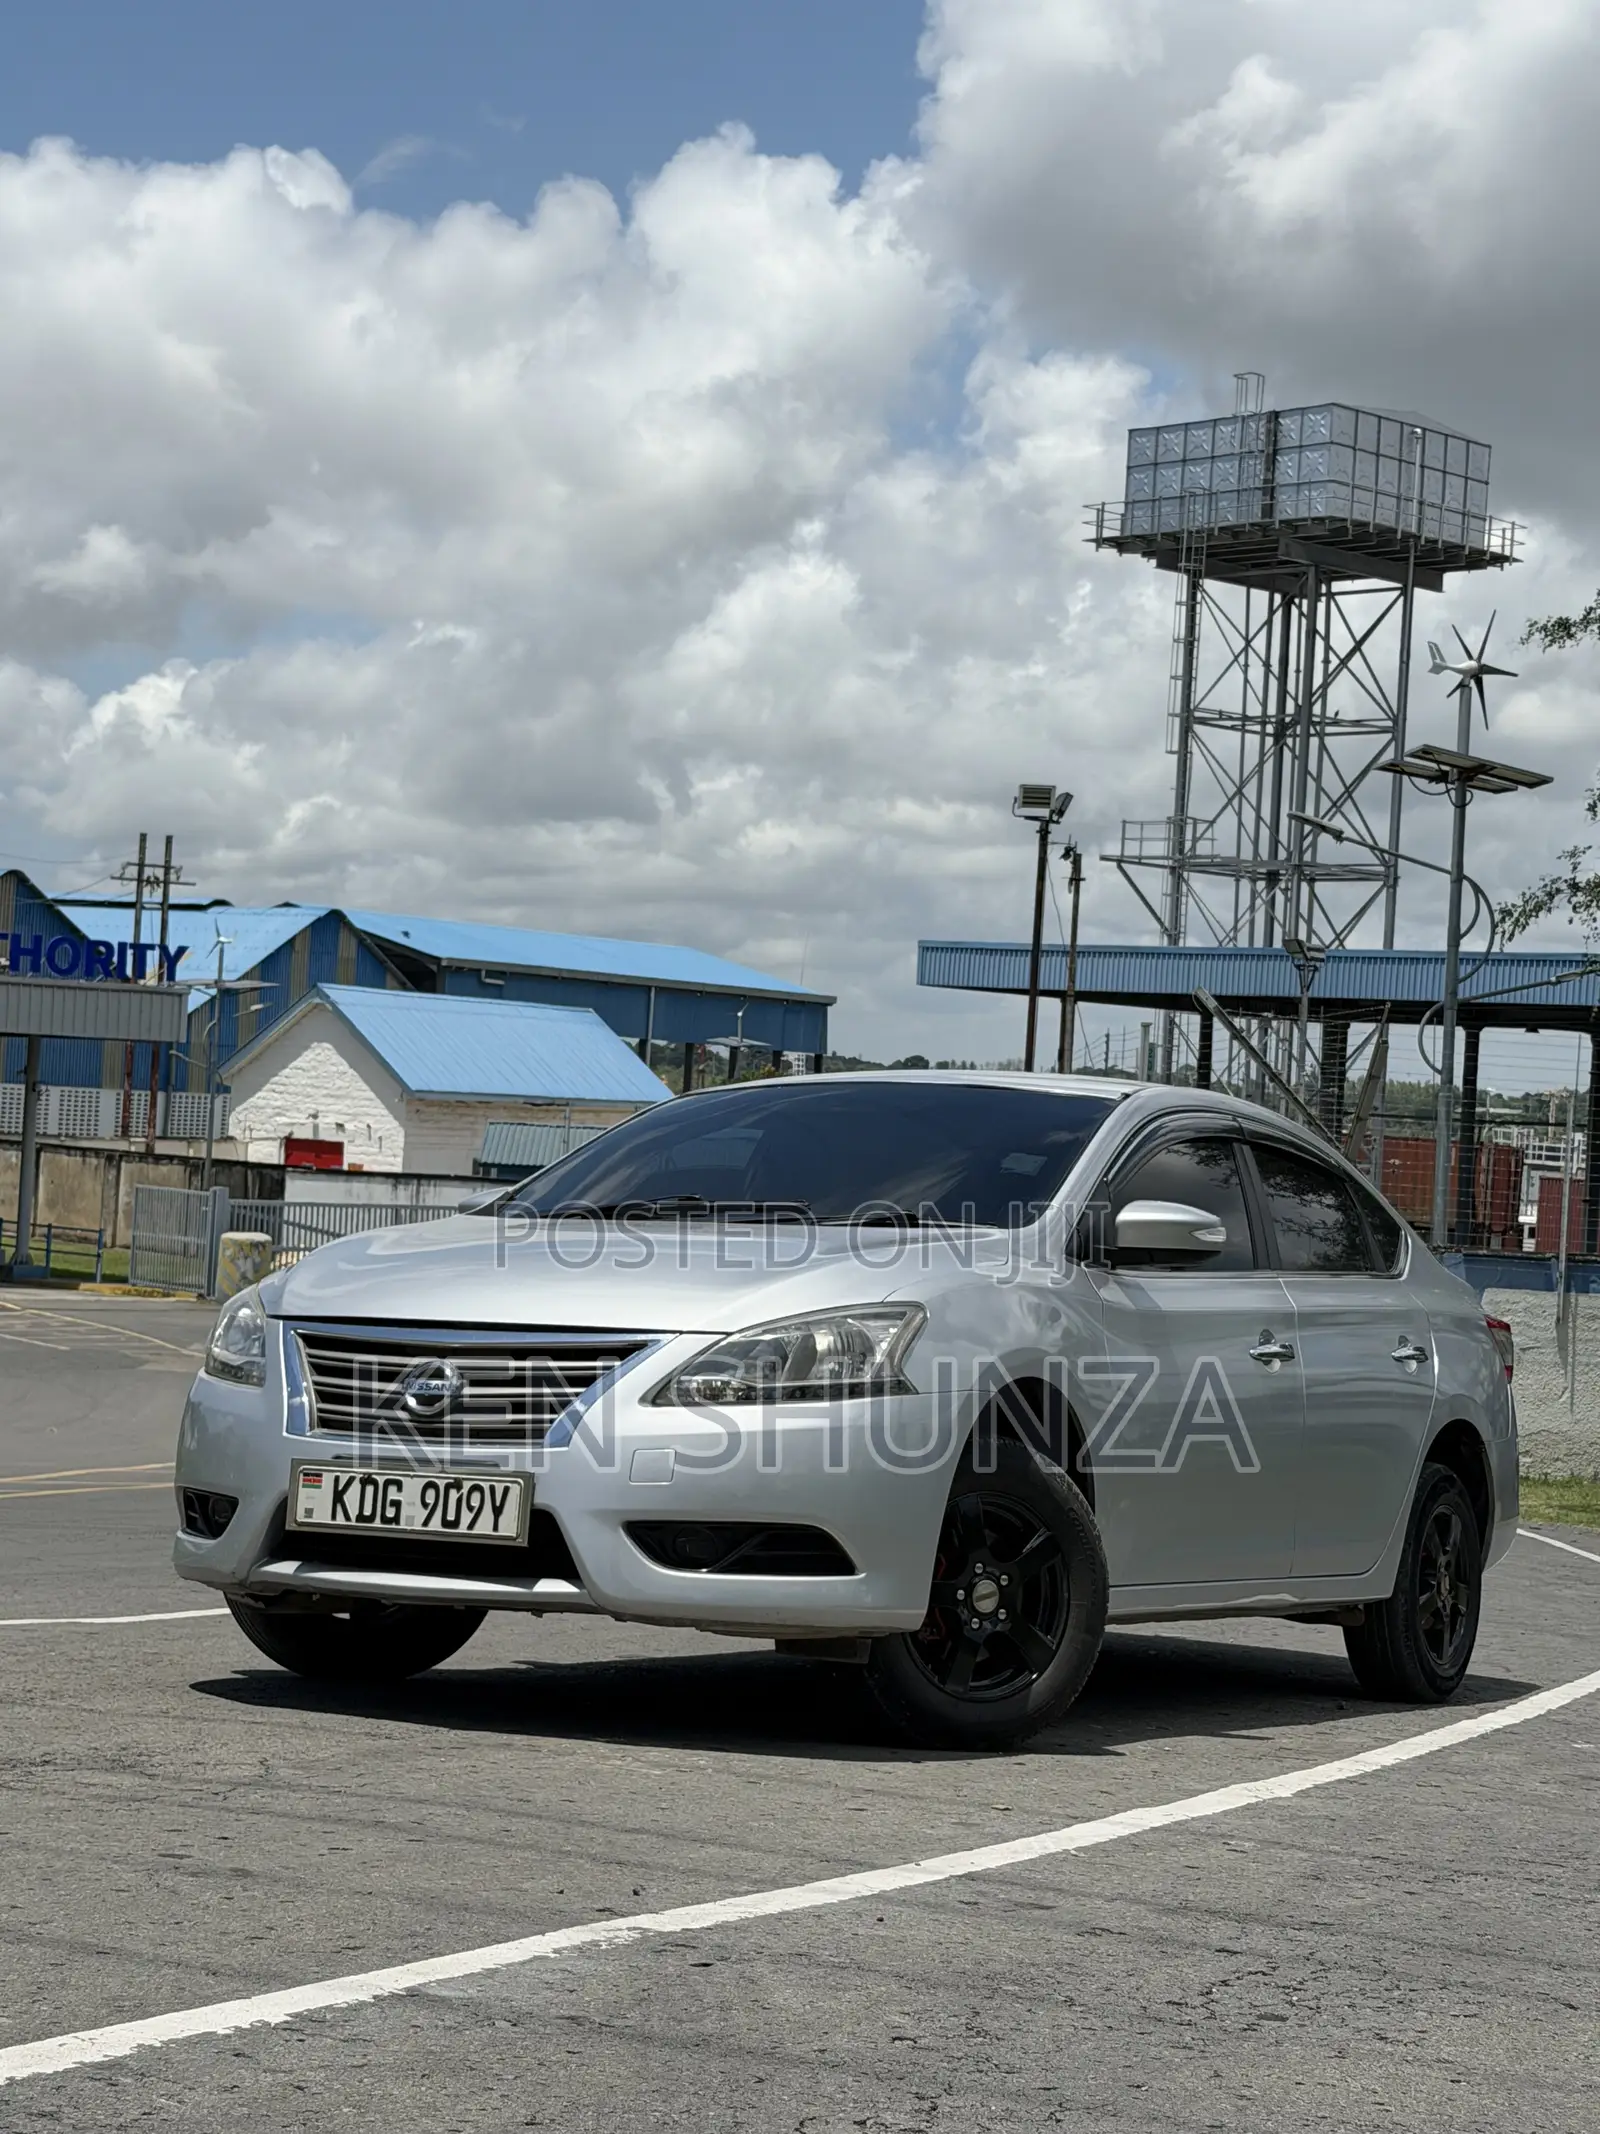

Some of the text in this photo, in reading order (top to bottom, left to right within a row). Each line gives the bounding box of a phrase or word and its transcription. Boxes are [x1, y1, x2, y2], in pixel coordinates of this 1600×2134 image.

[406, 1381, 452, 1392] NISSAN
[331, 1474, 511, 1532] KDG 909Y
